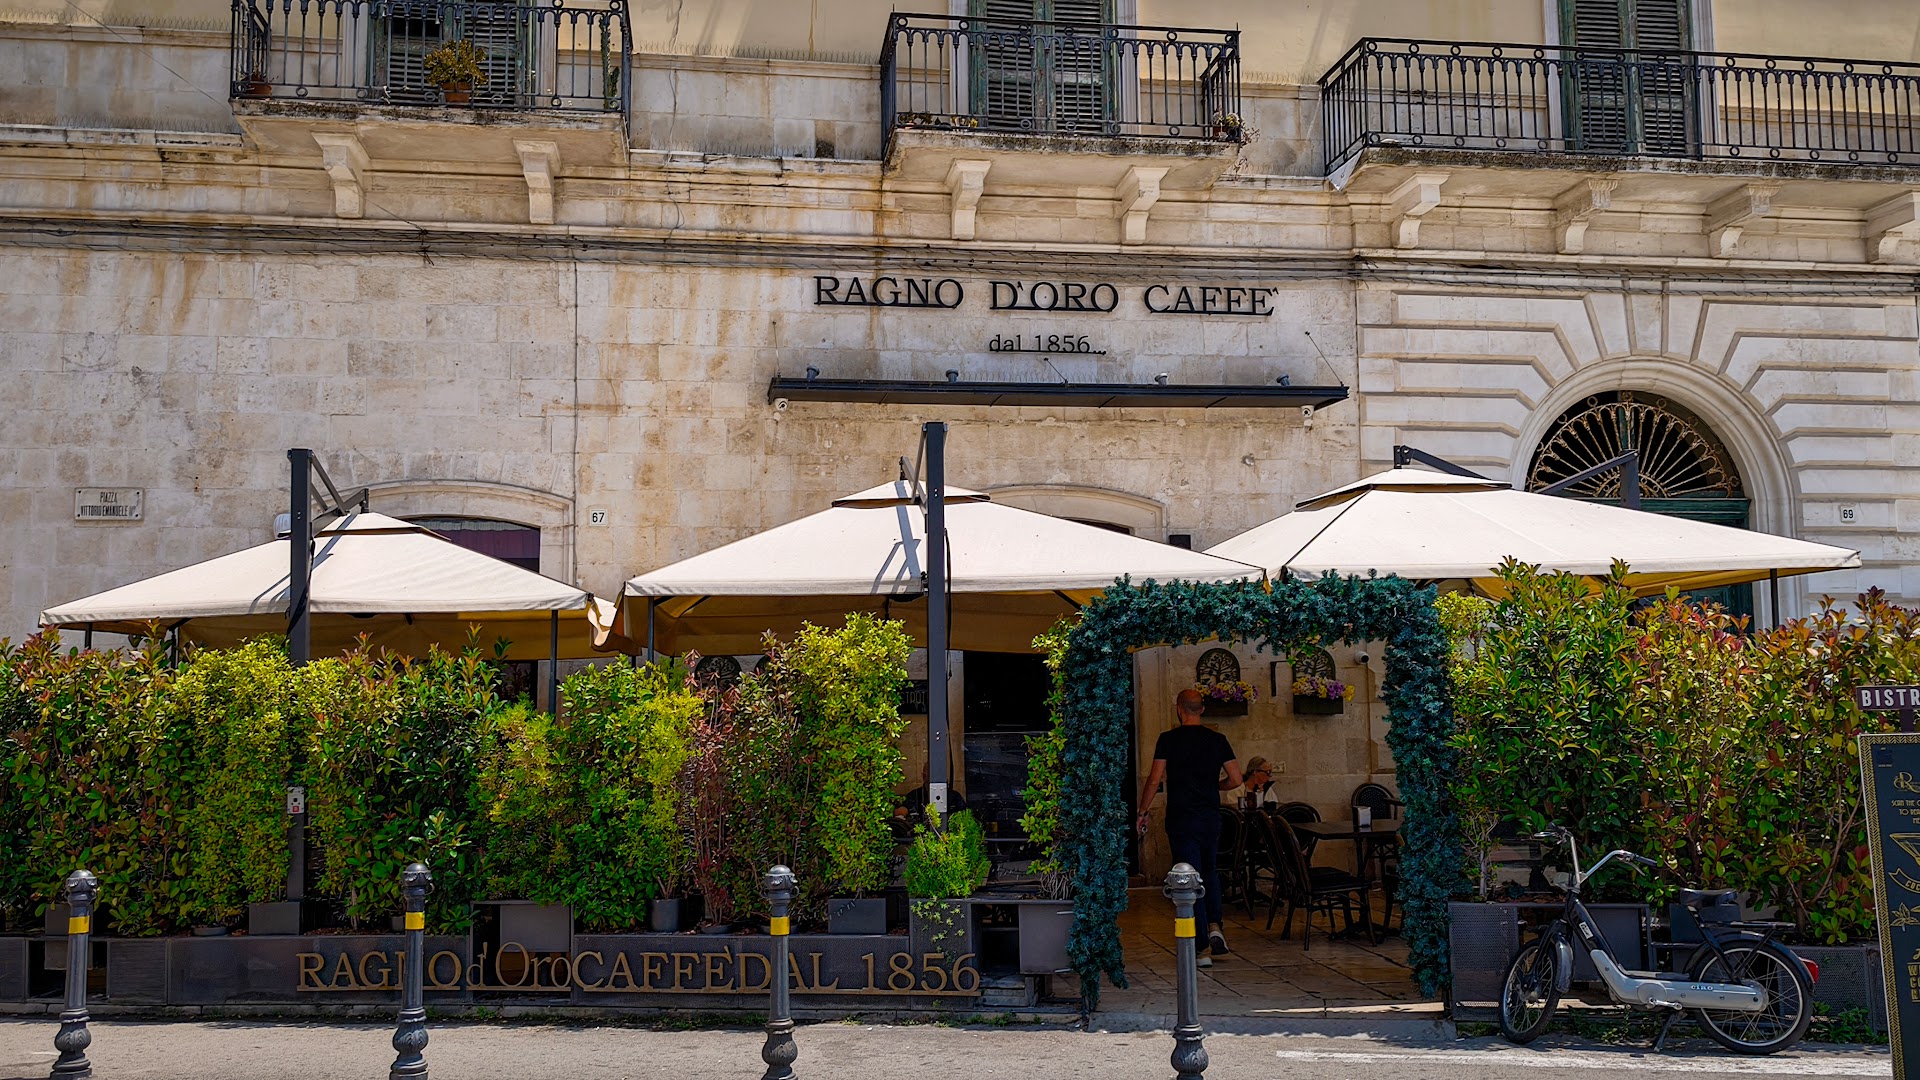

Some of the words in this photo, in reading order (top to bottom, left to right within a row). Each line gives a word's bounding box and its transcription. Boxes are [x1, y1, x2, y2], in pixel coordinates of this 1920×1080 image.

[813, 276, 964, 309] RAGNO
[989, 281, 1119, 313] D'ORO
[989, 334, 1022, 353] dal
[99, 491, 118, 503] PIAZZA
[80, 505, 102, 516] VITTORIO
[102, 505, 128, 517] EMANUELE
[1843, 509, 1854, 519] 69
[592, 512, 605, 523] 67
[861, 952, 982, 995] 1856
